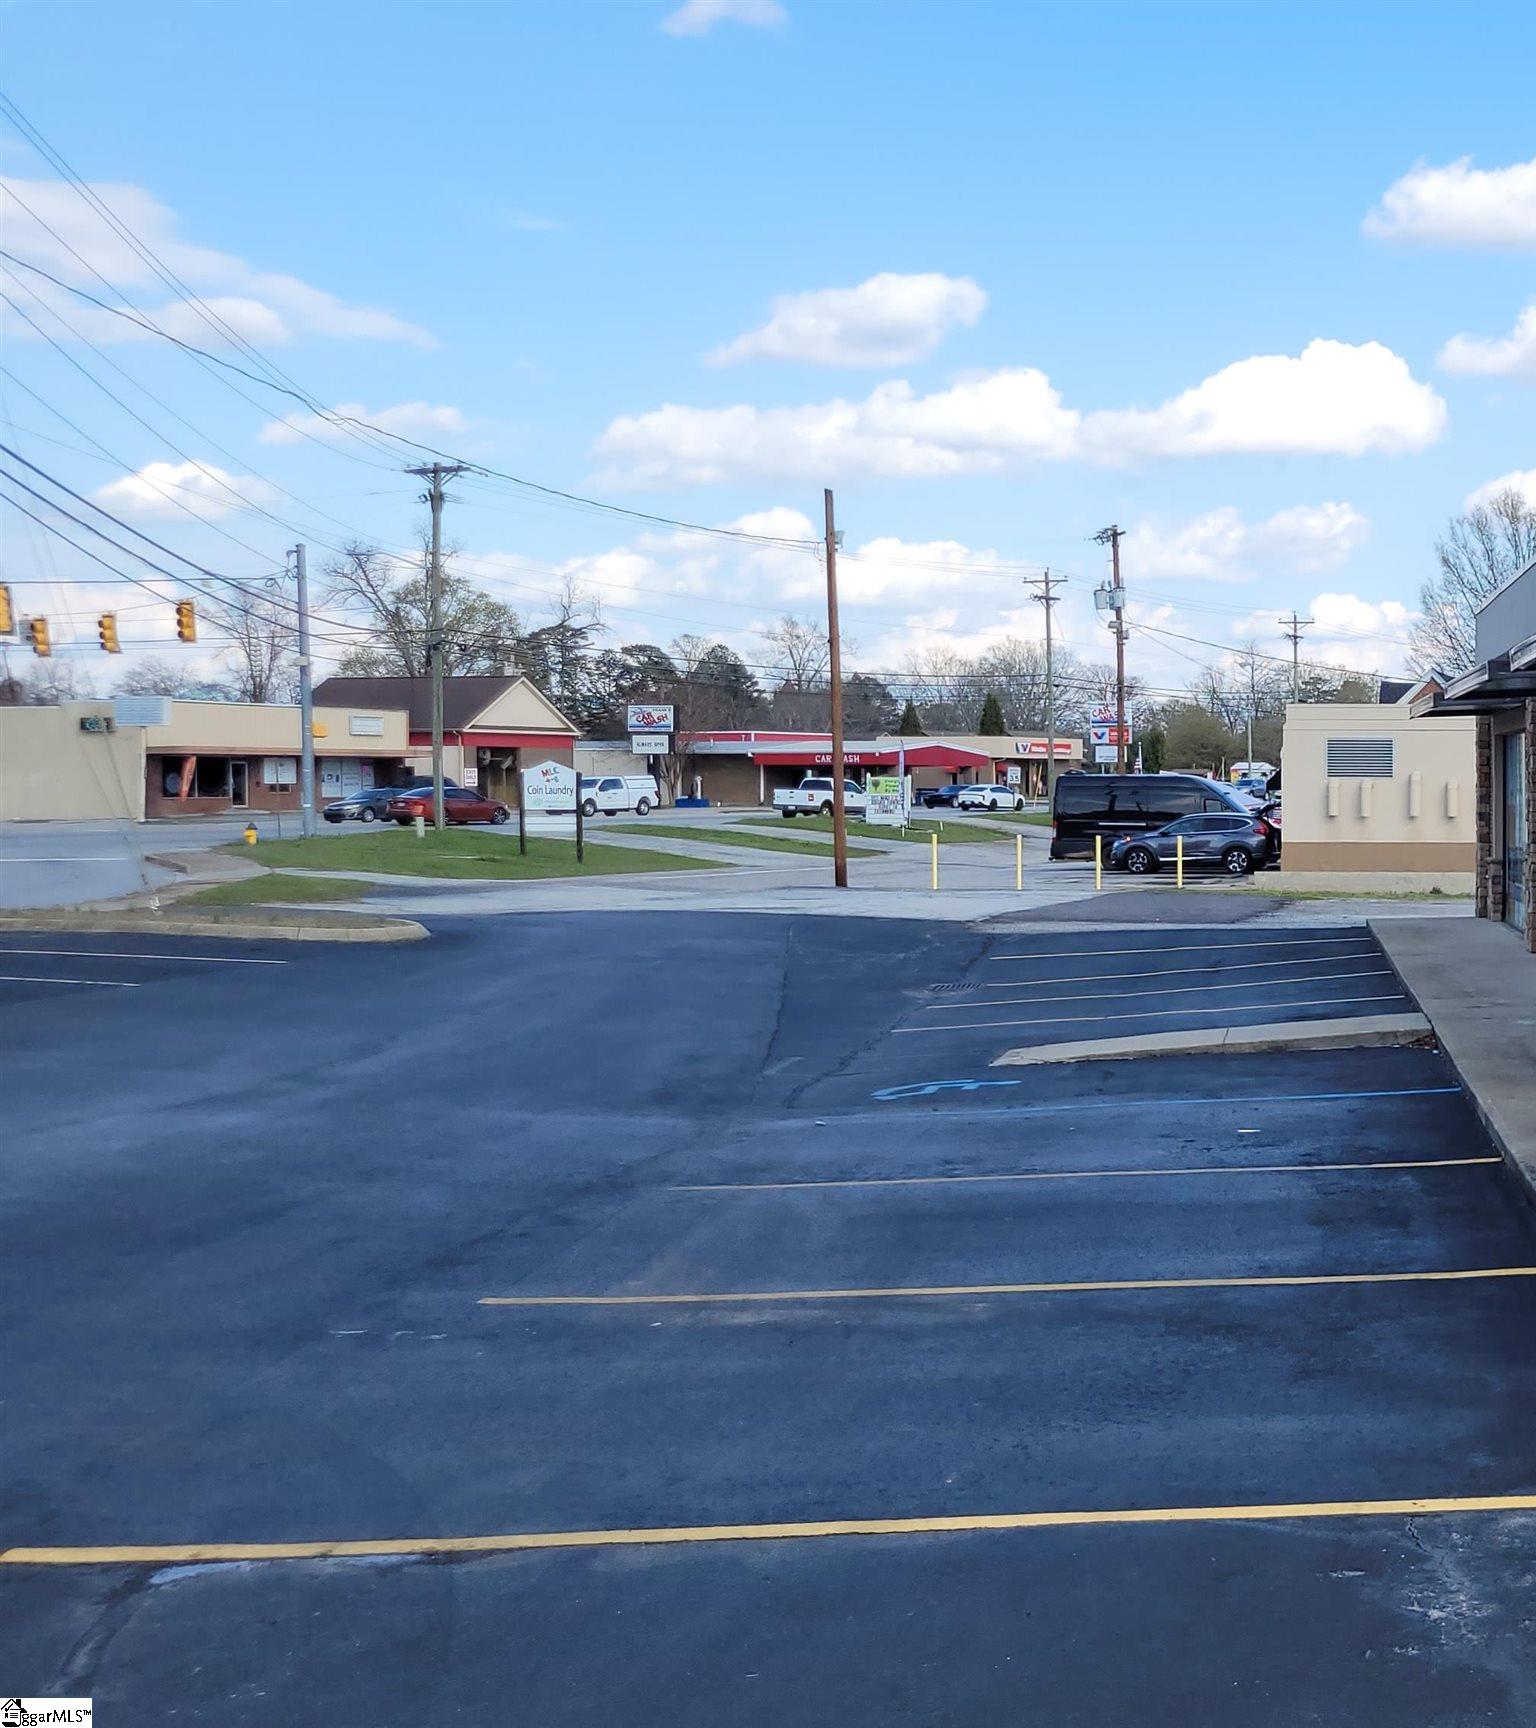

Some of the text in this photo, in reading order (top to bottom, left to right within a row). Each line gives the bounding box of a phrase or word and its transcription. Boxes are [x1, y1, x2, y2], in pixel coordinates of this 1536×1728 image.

[815, 754, 860, 763] CAR ASH
[541, 766, 560, 777] MLC
[527, 784, 575, 797] Coin Laundry
